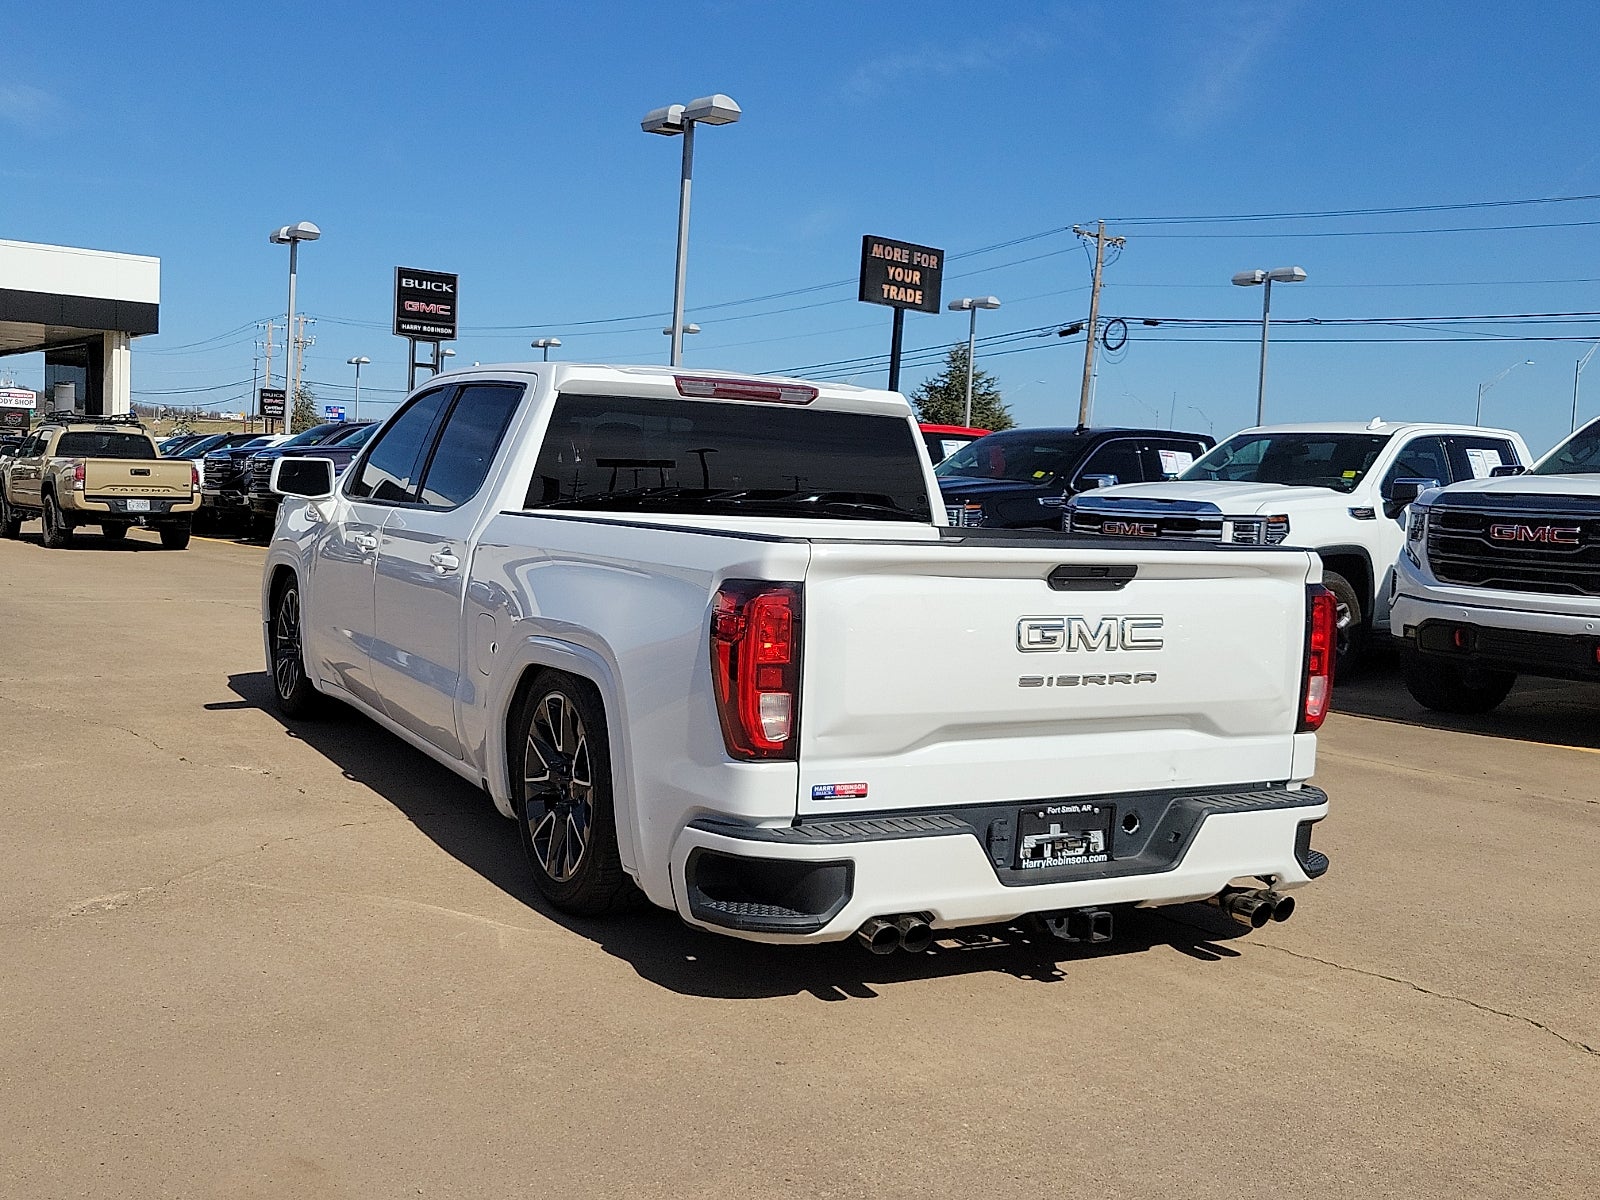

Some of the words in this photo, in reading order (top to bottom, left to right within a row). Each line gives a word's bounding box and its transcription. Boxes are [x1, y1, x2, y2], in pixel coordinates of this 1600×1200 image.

[871, 243, 909, 263] MORE
[913, 251, 938, 269] FOR
[887, 265, 921, 286] YOUR
[402, 278, 454, 293] BUICK
[882, 284, 923, 305] TRADE
[404, 300, 451, 316] GMC
[402, 323, 422, 331] HARRY
[422, 325, 453, 334] ROBINSON
[15, 398, 34, 406] SHOP
[1102, 521, 1158, 537] GMC
[1489, 523, 1582, 545] GMC
[1015, 613, 1165, 653] GMC
[1018, 672, 1158, 688] SIERRA
[1047, 806, 1061, 814] Fort
[1061, 804, 1081, 814] Smith,
[1081, 804, 1093, 812] AR
[1022, 854, 1107, 868] HarryRobinson.com
